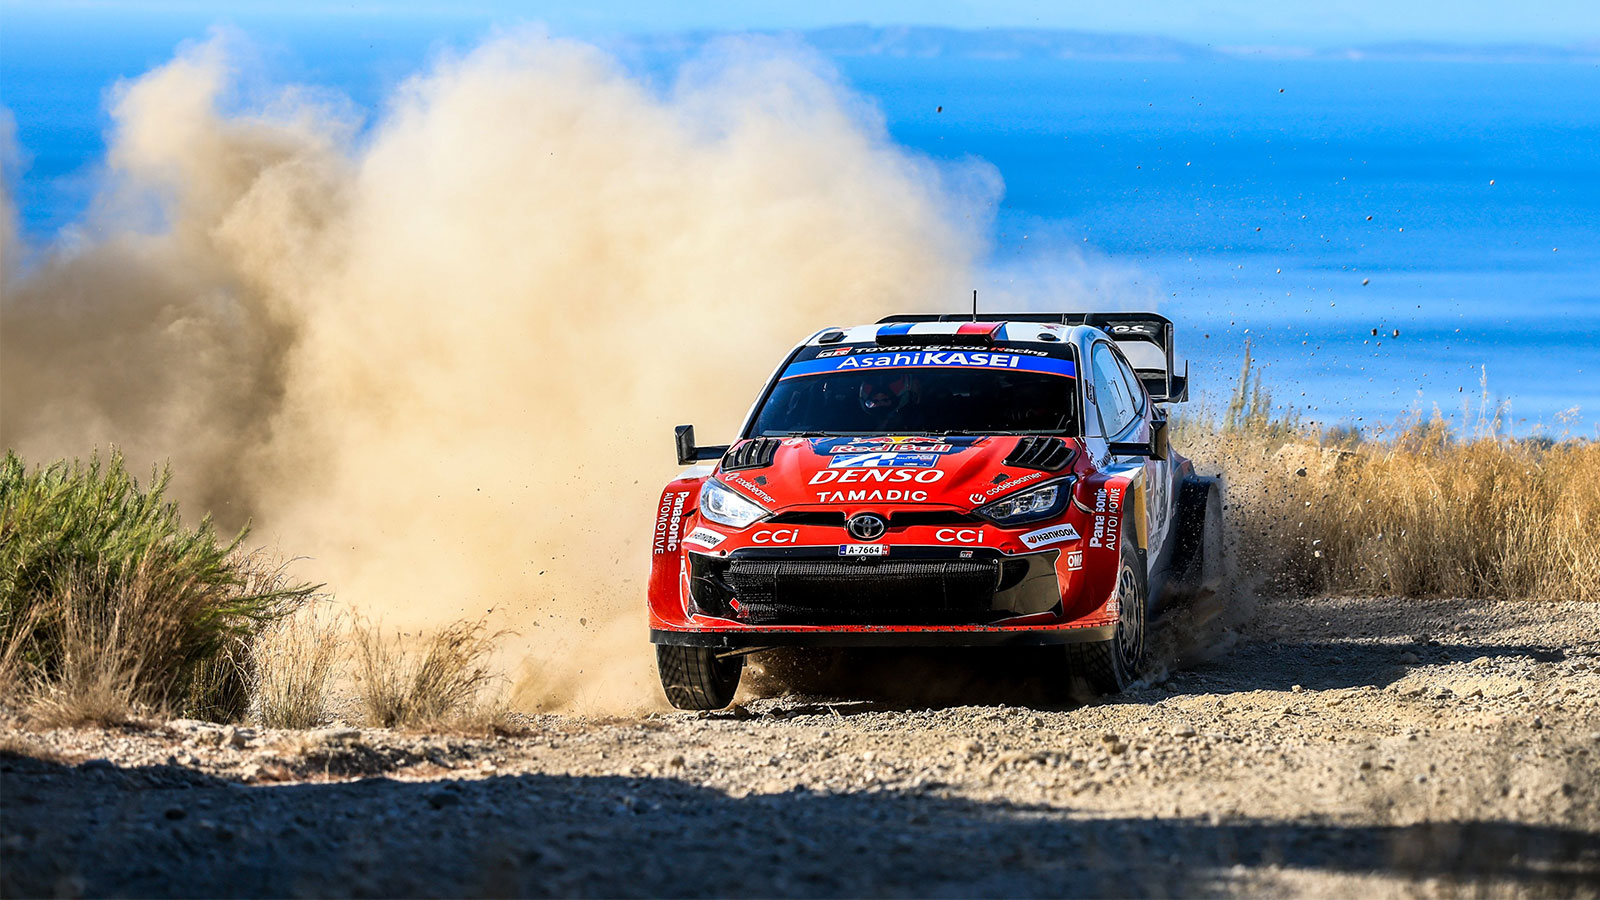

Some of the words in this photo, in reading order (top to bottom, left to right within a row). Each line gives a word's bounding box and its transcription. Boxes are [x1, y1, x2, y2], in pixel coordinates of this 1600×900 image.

[855, 345, 921, 354] TOYOTA
[991, 347, 1049, 357] Racing
[829, 444, 893, 453] Red
[891, 444, 953, 453] Bull
[808, 469, 945, 485] DENSO
[986, 472, 1042, 496] codebeamer
[736, 476, 776, 504] codebeamer
[816, 489, 928, 502] TAMADIC
[654, 492, 674, 554] AUTOMOTIVE
[667, 491, 690, 552] Panasonic
[1089, 488, 1108, 548] Panasonic
[848, 546, 880, 554] A-7664
[1067, 554, 1083, 567] OMP
